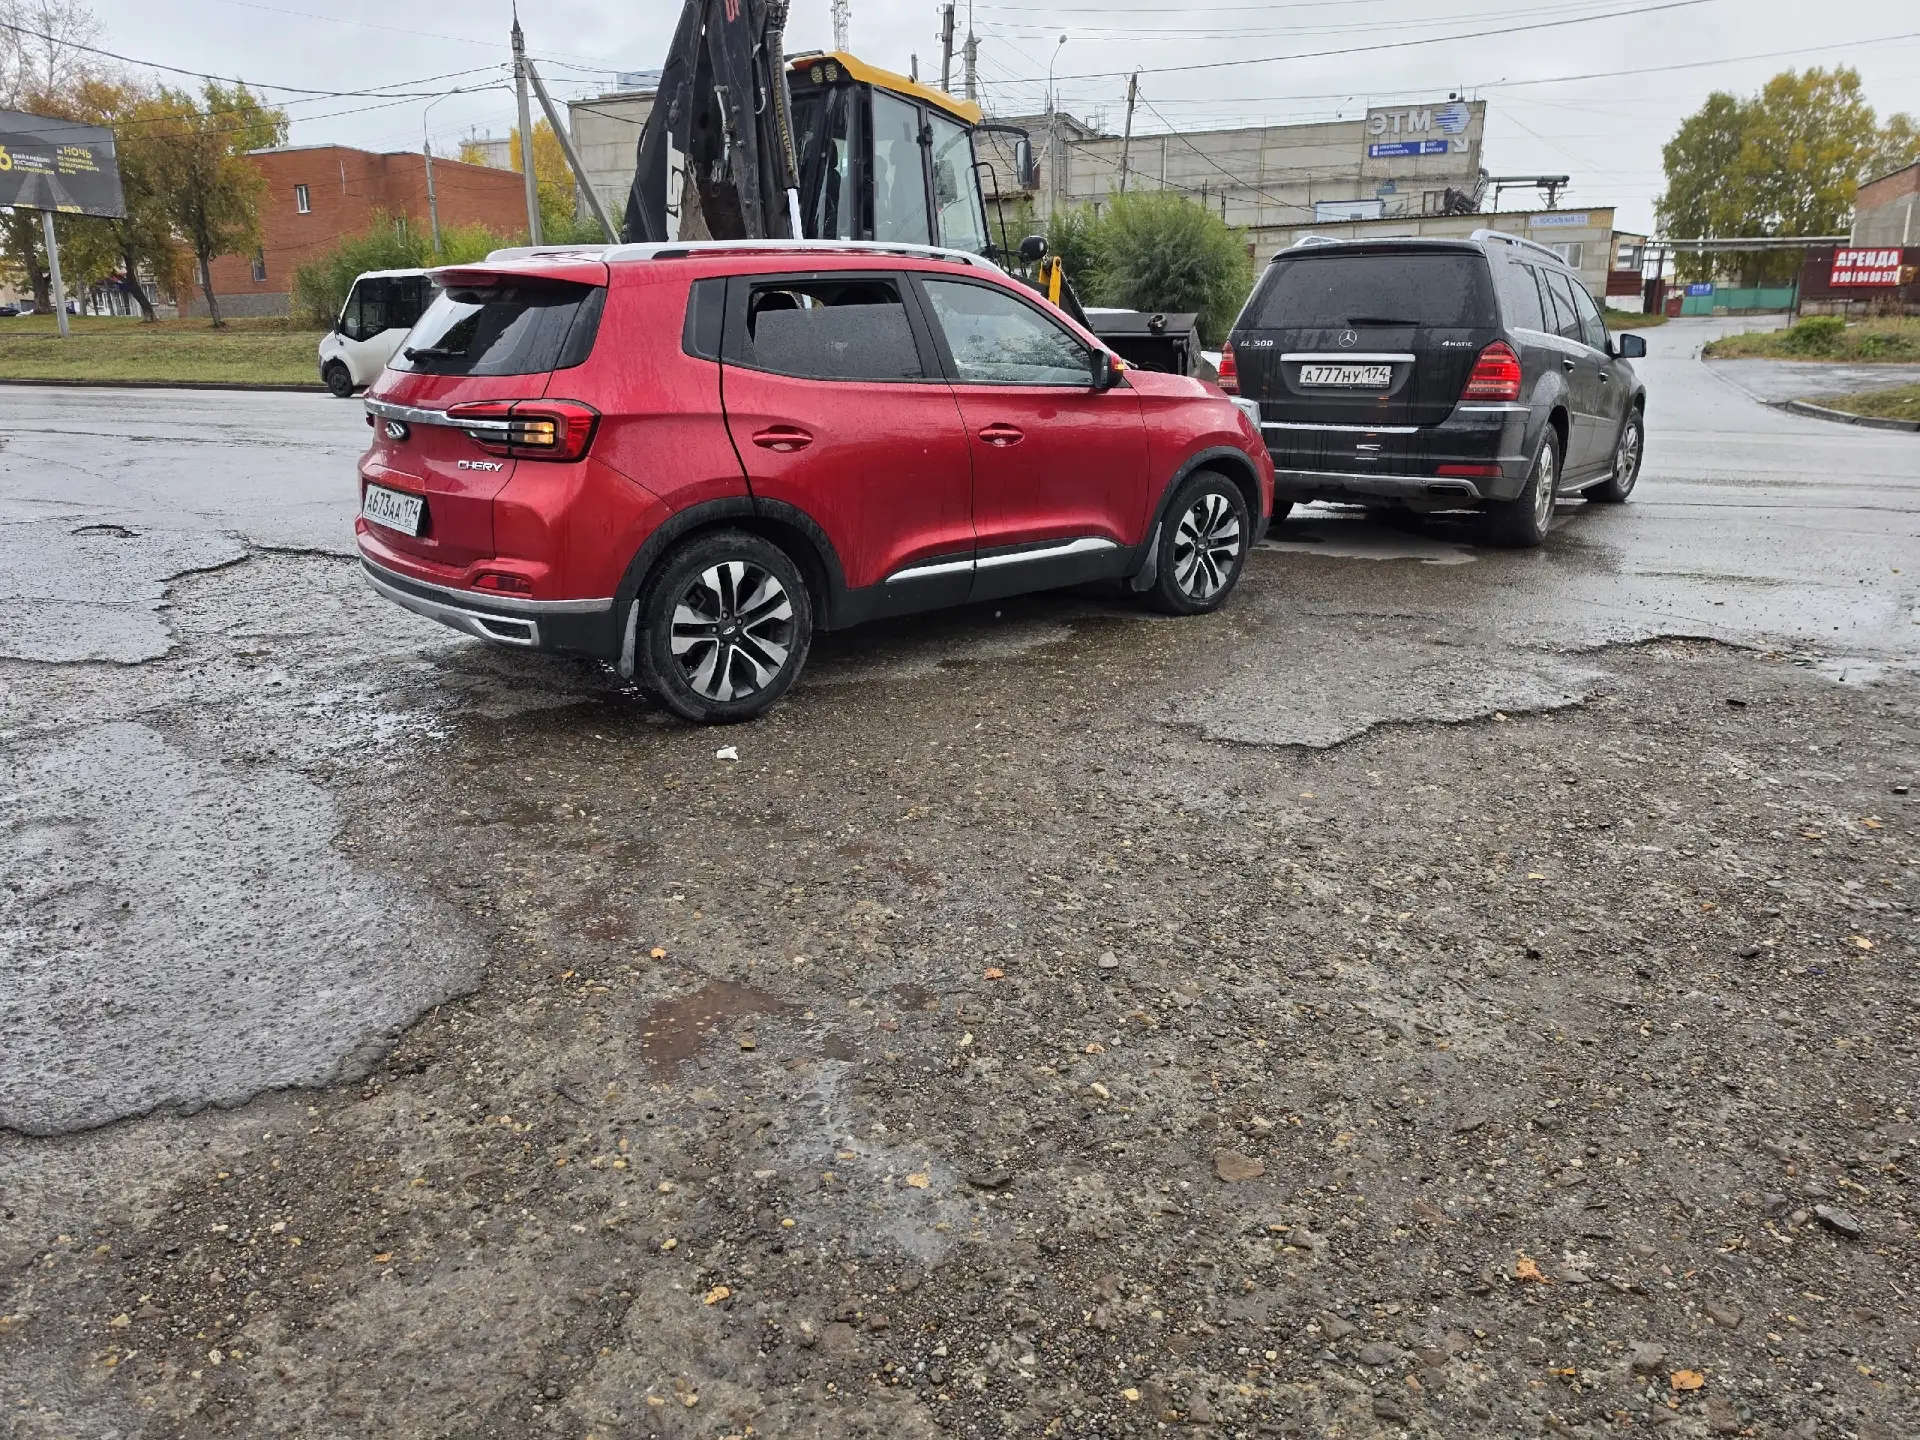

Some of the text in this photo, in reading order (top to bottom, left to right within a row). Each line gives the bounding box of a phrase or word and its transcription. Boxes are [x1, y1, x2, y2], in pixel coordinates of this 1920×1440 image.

[1369, 109, 1431, 135] ЭТМ
[64, 146, 92, 159] НОЧЬ
[1835, 250, 1899, 268] АРЕНДА
[1364, 367, 1387, 380] 174
[457, 459, 503, 472] CHERY
[404, 498, 419, 520] 174
